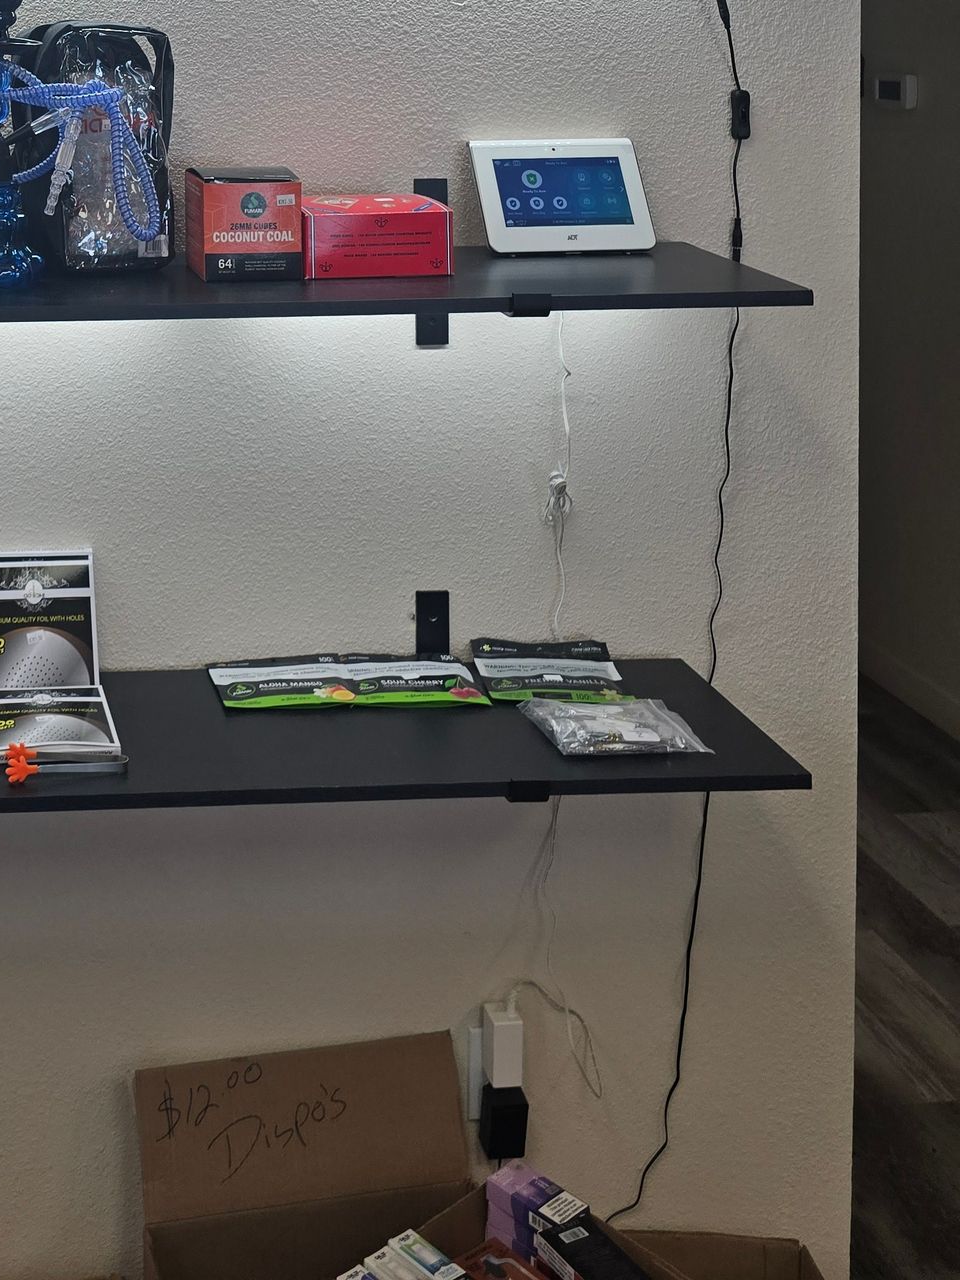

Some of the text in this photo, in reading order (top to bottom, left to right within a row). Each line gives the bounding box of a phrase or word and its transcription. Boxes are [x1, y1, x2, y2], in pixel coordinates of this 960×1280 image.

[230, 222, 278, 231] 26MM CUBES
[213, 230, 295, 243] COCONUT COAL
[218, 259, 233, 269] 64
[12, 616, 36, 624] QUALITY
[289, 680, 323, 688] MANGO
[567, 678, 607, 686] VANILLA
[156, 1062, 263, 1143] $12.00
[207, 1083, 348, 1185] Dispo's
